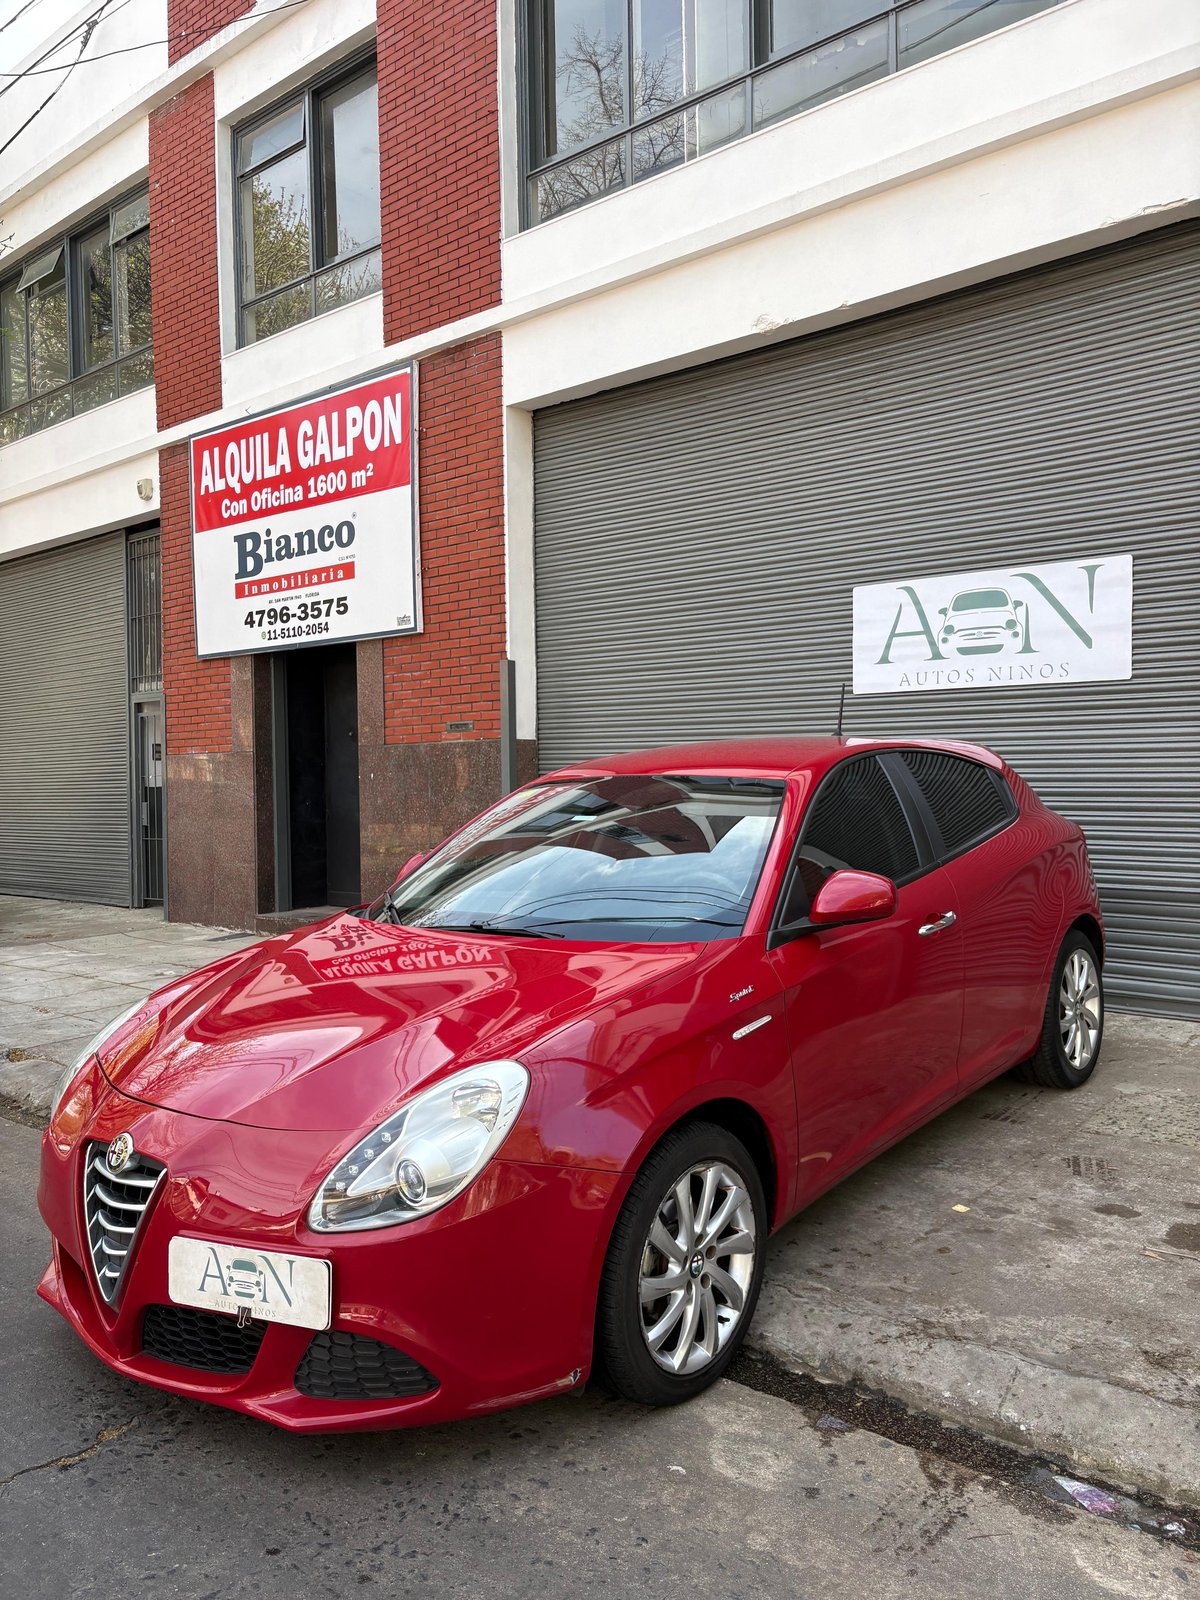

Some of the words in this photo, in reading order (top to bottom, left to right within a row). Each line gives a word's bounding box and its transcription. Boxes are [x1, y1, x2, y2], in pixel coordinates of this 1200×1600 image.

[200, 426, 292, 495] ALQUILA
[296, 392, 403, 470] GALPON
[221, 493, 248, 518] Con
[250, 484, 303, 511] Oficina
[307, 469, 347, 499] 1600
[233, 520, 356, 580] Bianco
[244, 568, 344, 596] Inmobiliaria
[244, 596, 349, 628] 4796-3575
[267, 621, 329, 641] 11-5110-2054
[899, 667, 975, 687] AUTOS
[987, 662, 1070, 682] NINOS
